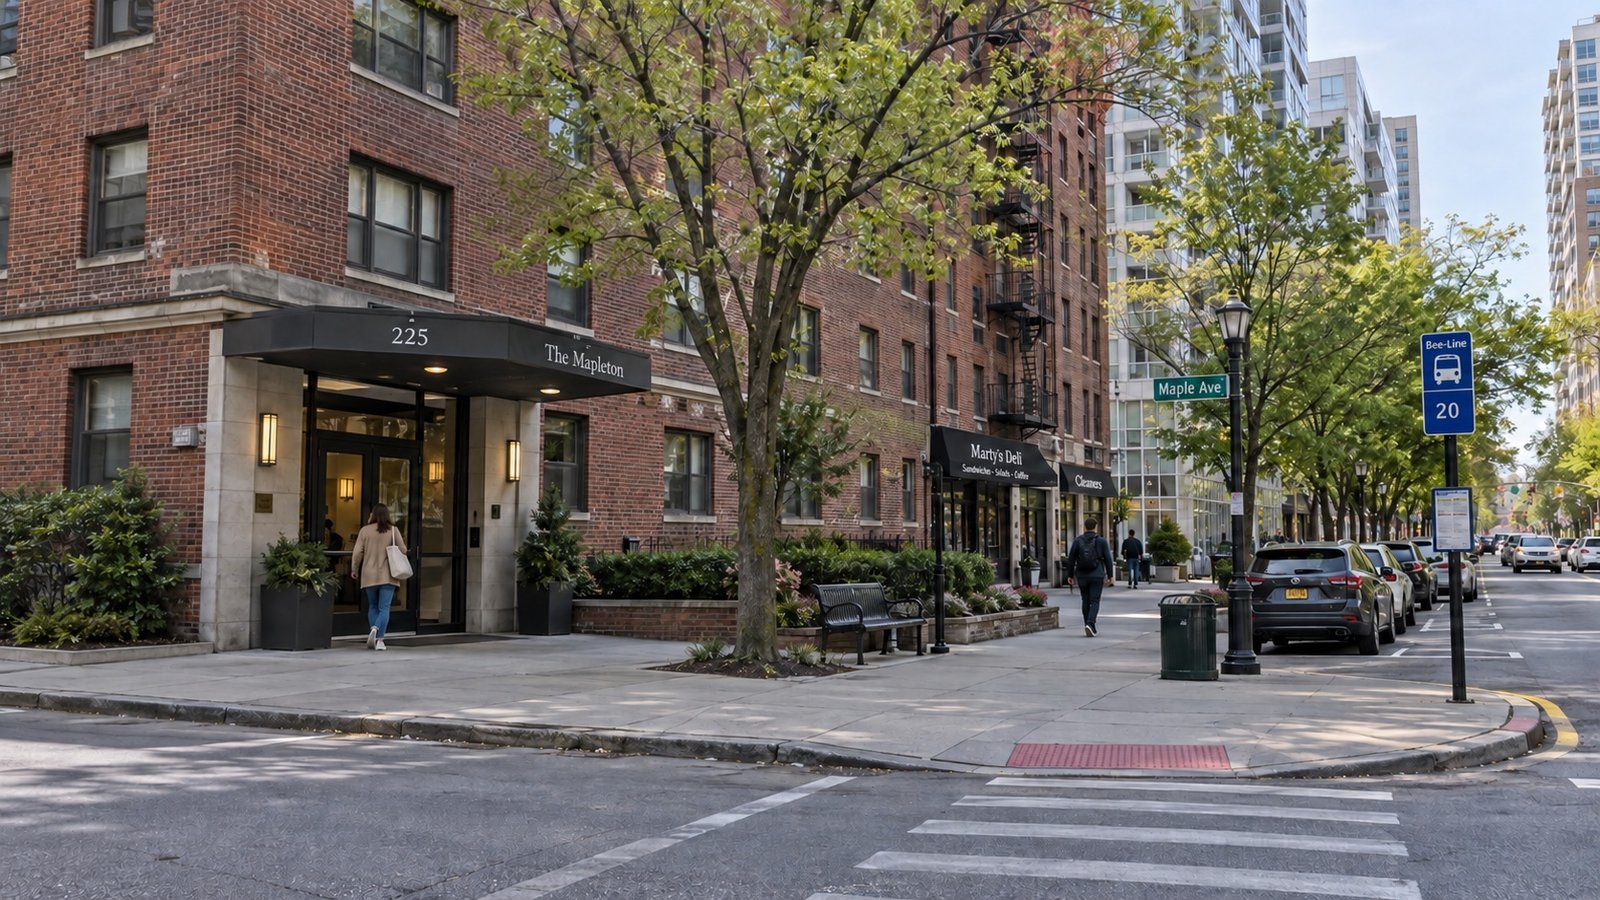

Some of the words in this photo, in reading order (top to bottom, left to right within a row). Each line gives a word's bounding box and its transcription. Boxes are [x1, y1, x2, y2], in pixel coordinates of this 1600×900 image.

[391, 327, 429, 346] 225
[1425, 339, 1468, 350] Bee-Line
[544, 343, 569, 366] The
[572, 350, 625, 378] Mapleton
[1158, 381, 1195, 398] Maple
[1198, 380, 1221, 394] Ave
[1435, 402, 1460, 419] 20
[970, 443, 1004, 466] Marty's
[1005, 449, 1023, 466] Deli
[1074, 474, 1103, 490] Cleaners
